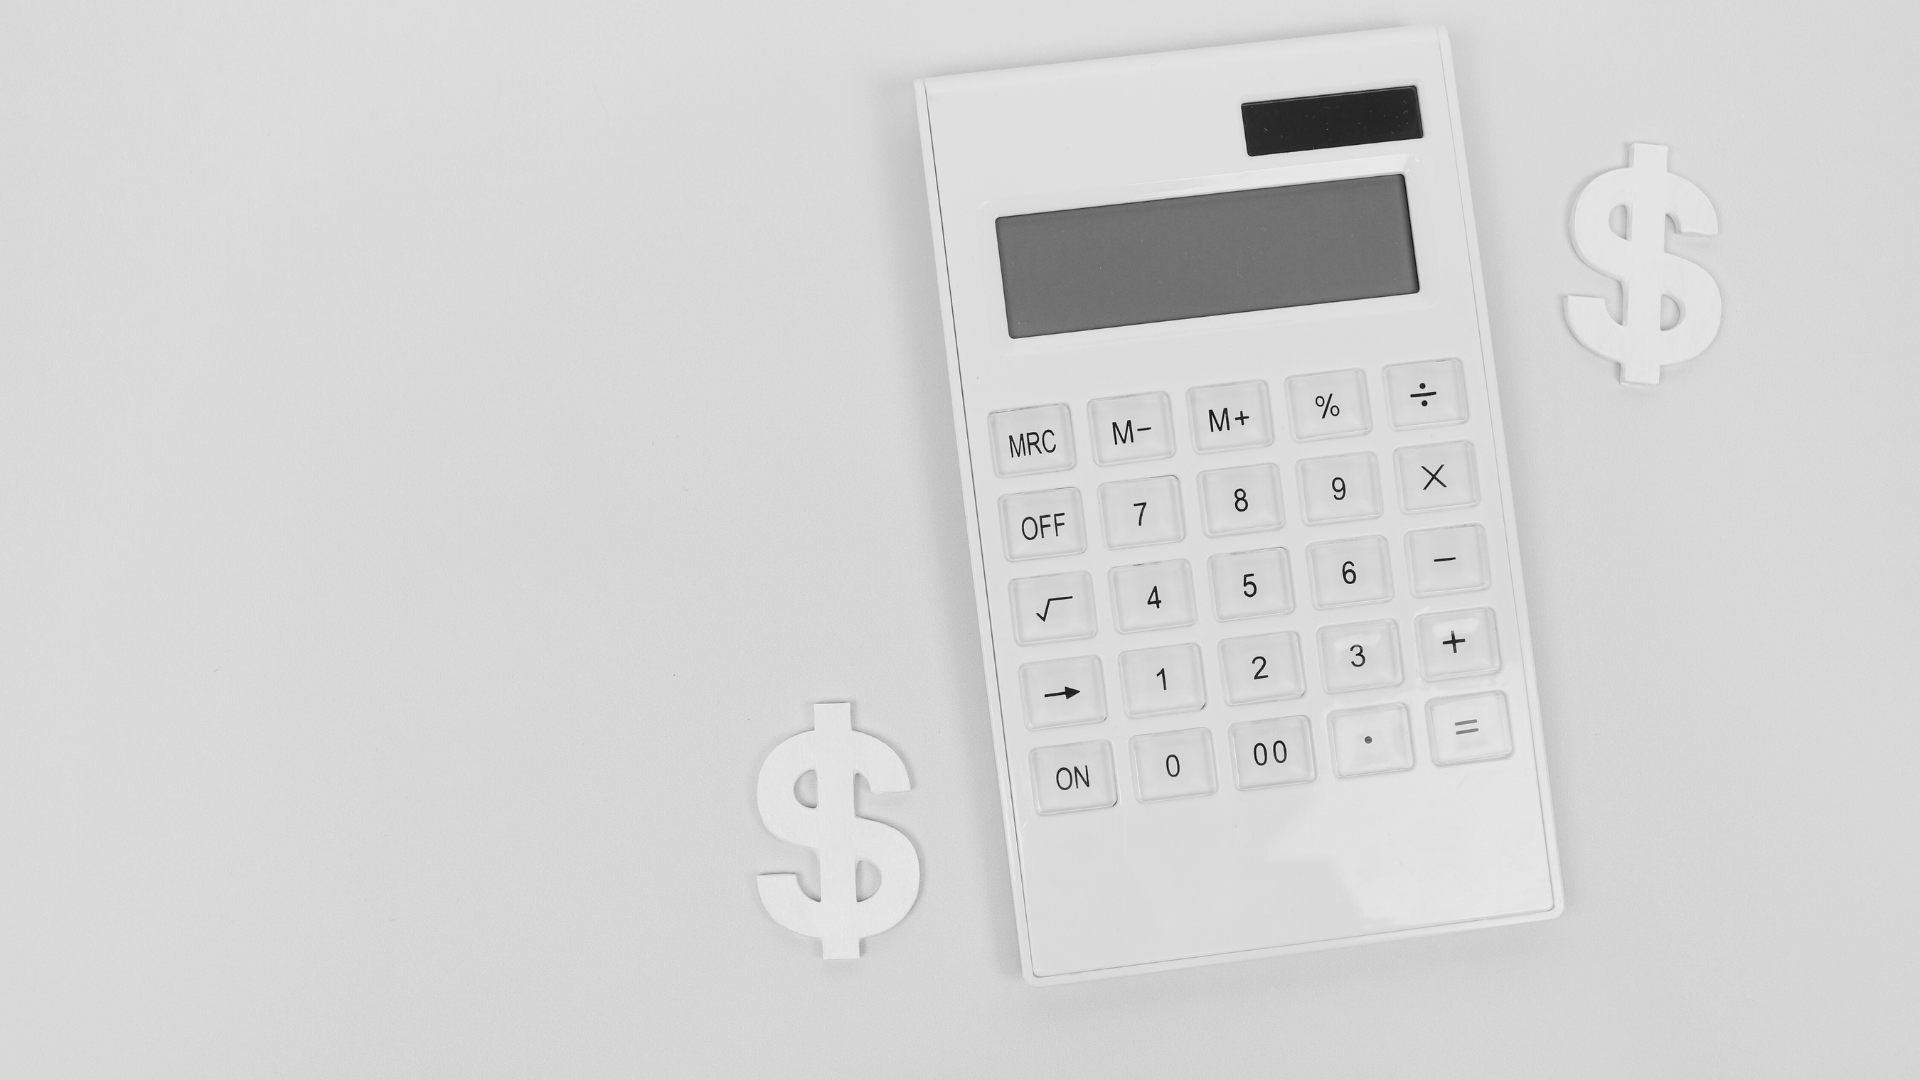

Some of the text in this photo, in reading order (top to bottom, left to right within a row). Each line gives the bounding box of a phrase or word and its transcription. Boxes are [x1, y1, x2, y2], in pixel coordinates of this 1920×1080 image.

[1563, 142, 1722, 385] $
[1314, 392, 1340, 420] %
[1208, 407, 1250, 433] M+
[1008, 429, 1058, 459] MRC
[1233, 487, 1249, 513] 8
[1331, 476, 1347, 501] 9
[1020, 512, 1067, 541] OFF
[1133, 501, 1148, 527] 7
[1242, 573, 1258, 598] 5
[1341, 560, 1357, 585] 6
[1146, 585, 1163, 609] 4
[1251, 655, 1269, 680] 2
[1349, 644, 1367, 668] 3
[1155, 667, 1168, 691] 1
[1165, 754, 1181, 778] 0
[1252, 739, 1288, 768] 00
[1054, 763, 1091, 792] ON
[756, 701, 920, 960] $
